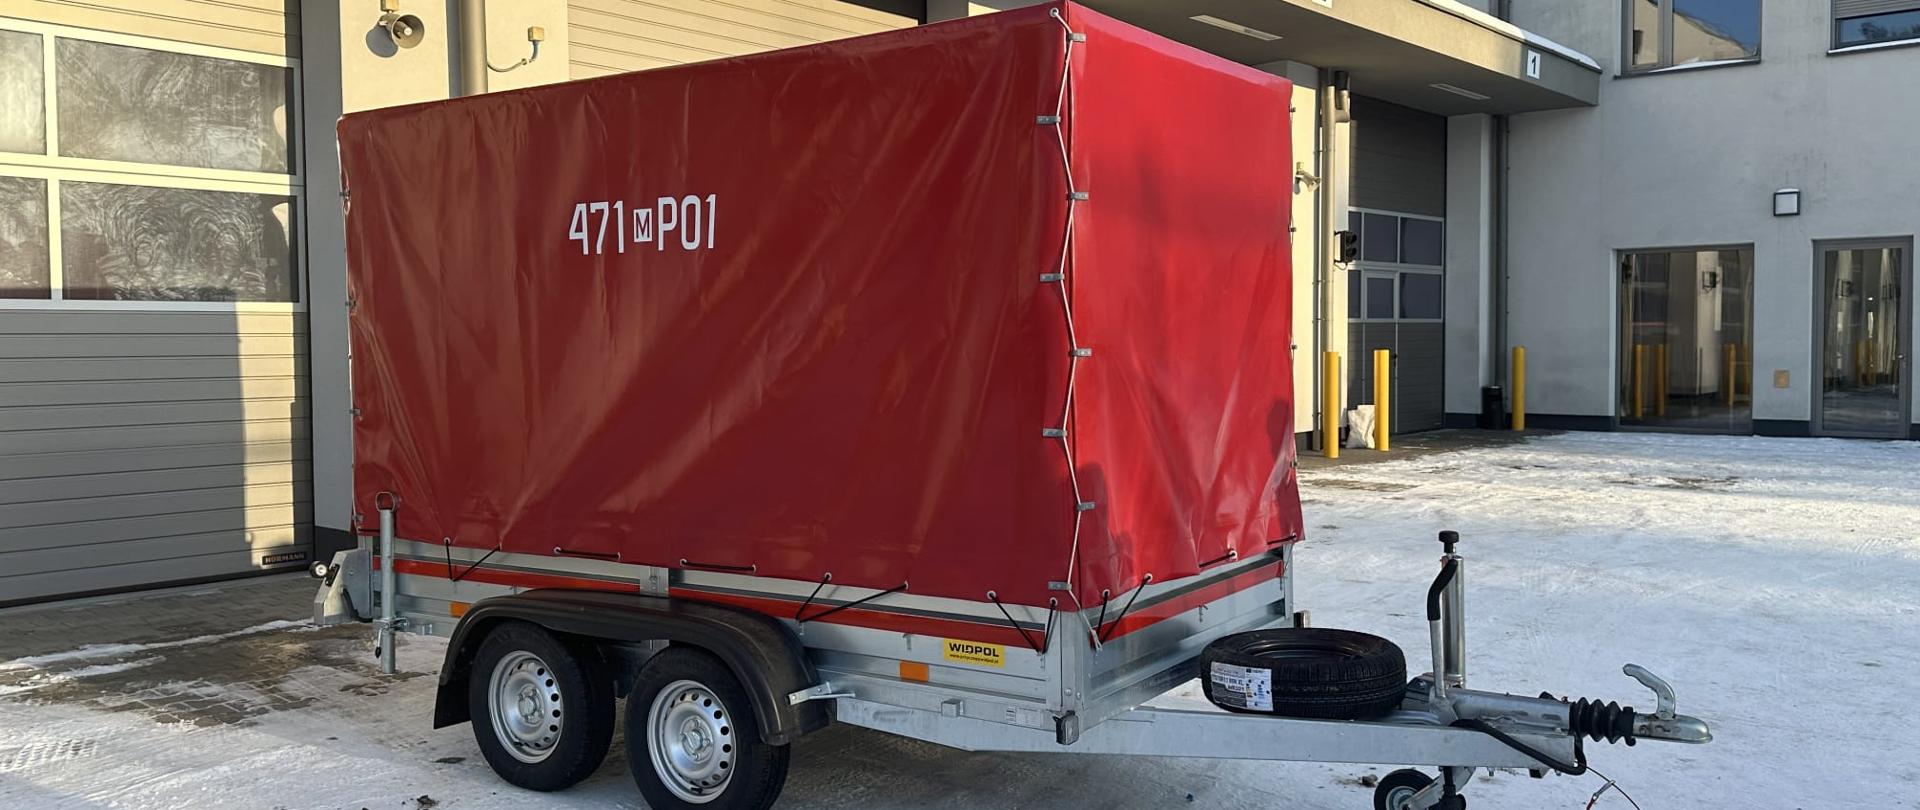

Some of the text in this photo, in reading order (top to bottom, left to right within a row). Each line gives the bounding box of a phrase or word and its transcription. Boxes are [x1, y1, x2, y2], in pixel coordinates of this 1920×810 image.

[1532, 55, 1536, 75] 1
[569, 200, 624, 255] 471
[949, 643, 999, 657] WIDPOL
